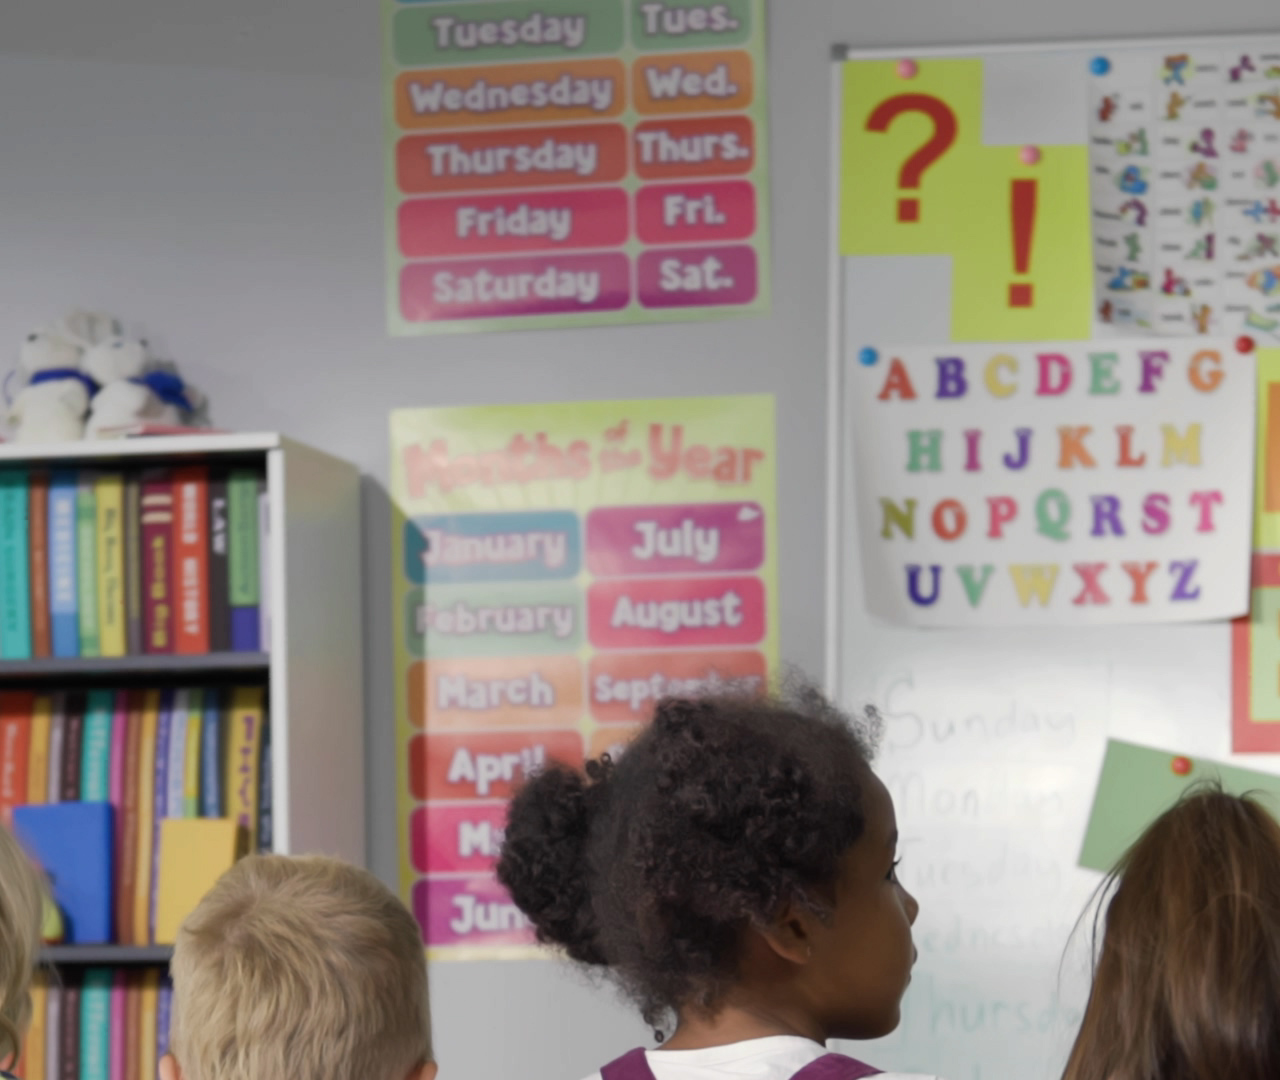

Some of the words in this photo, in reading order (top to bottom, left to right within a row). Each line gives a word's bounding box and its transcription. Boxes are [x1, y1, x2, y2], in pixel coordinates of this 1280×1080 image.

[432, 14, 585, 48] Tuesday
[642, 4, 739, 34] Tues.
[409, 75, 613, 113] Wednesday
[646, 65, 739, 98] Wed.
[426, 140, 597, 176] Thursday
[637, 131, 749, 163] Thurs.
[865, 92, 958, 222] ?
[456, 205, 571, 241] Friday
[663, 195, 726, 226] Fri.
[1007, 179, 1037, 308] !
[432, 266, 599, 303] Saturday
[659, 257, 733, 291] Sat.
[878, 356, 917, 401] A
[935, 356, 968, 399] B
[984, 354, 1019, 398] C
[1036, 353, 1071, 396] D
[1088, 352, 1120, 395] E
[1138, 350, 1170, 393] F
[1187, 350, 1224, 392] G
[403, 432, 592, 499] Months
[604, 419, 630, 442] of
[648, 422, 764, 485] Year
[905, 429, 943, 472] H
[964, 429, 982, 472] I
[1003, 428, 1033, 470] J
[1057, 426, 1097, 469] K
[1116, 425, 1146, 468] L
[1161, 423, 1202, 467] M
[183, 483, 199, 544] WORLD
[211, 497, 227, 557] LAW
[879, 497, 917, 540] N
[931, 498, 966, 540] O
[986, 496, 1018, 538] P
[1035, 488, 1071, 541] Q
[1090, 495, 1125, 537] R
[1141, 492, 1172, 536] S
[1190, 490, 1223, 532] T
[421, 530, 566, 568] January
[632, 519, 719, 563] July
[184, 557, 200, 634] HISTORY
[904, 564, 942, 607] U
[956, 564, 994, 607] V
[1009, 563, 1060, 607] W
[1073, 562, 1110, 605] X
[1121, 562, 1159, 604] Y
[1169, 560, 1201, 602] Z
[417, 603, 573, 638] February
[611, 590, 743, 632] August
[437, 672, 555, 711] March
[884, 672, 1077, 754] Sunday
[447, 745, 544, 795] April
[450, 894, 528, 934] Jun
[923, 913, 1066, 953] ednesd
[902, 970, 1078, 1045] Thursda
